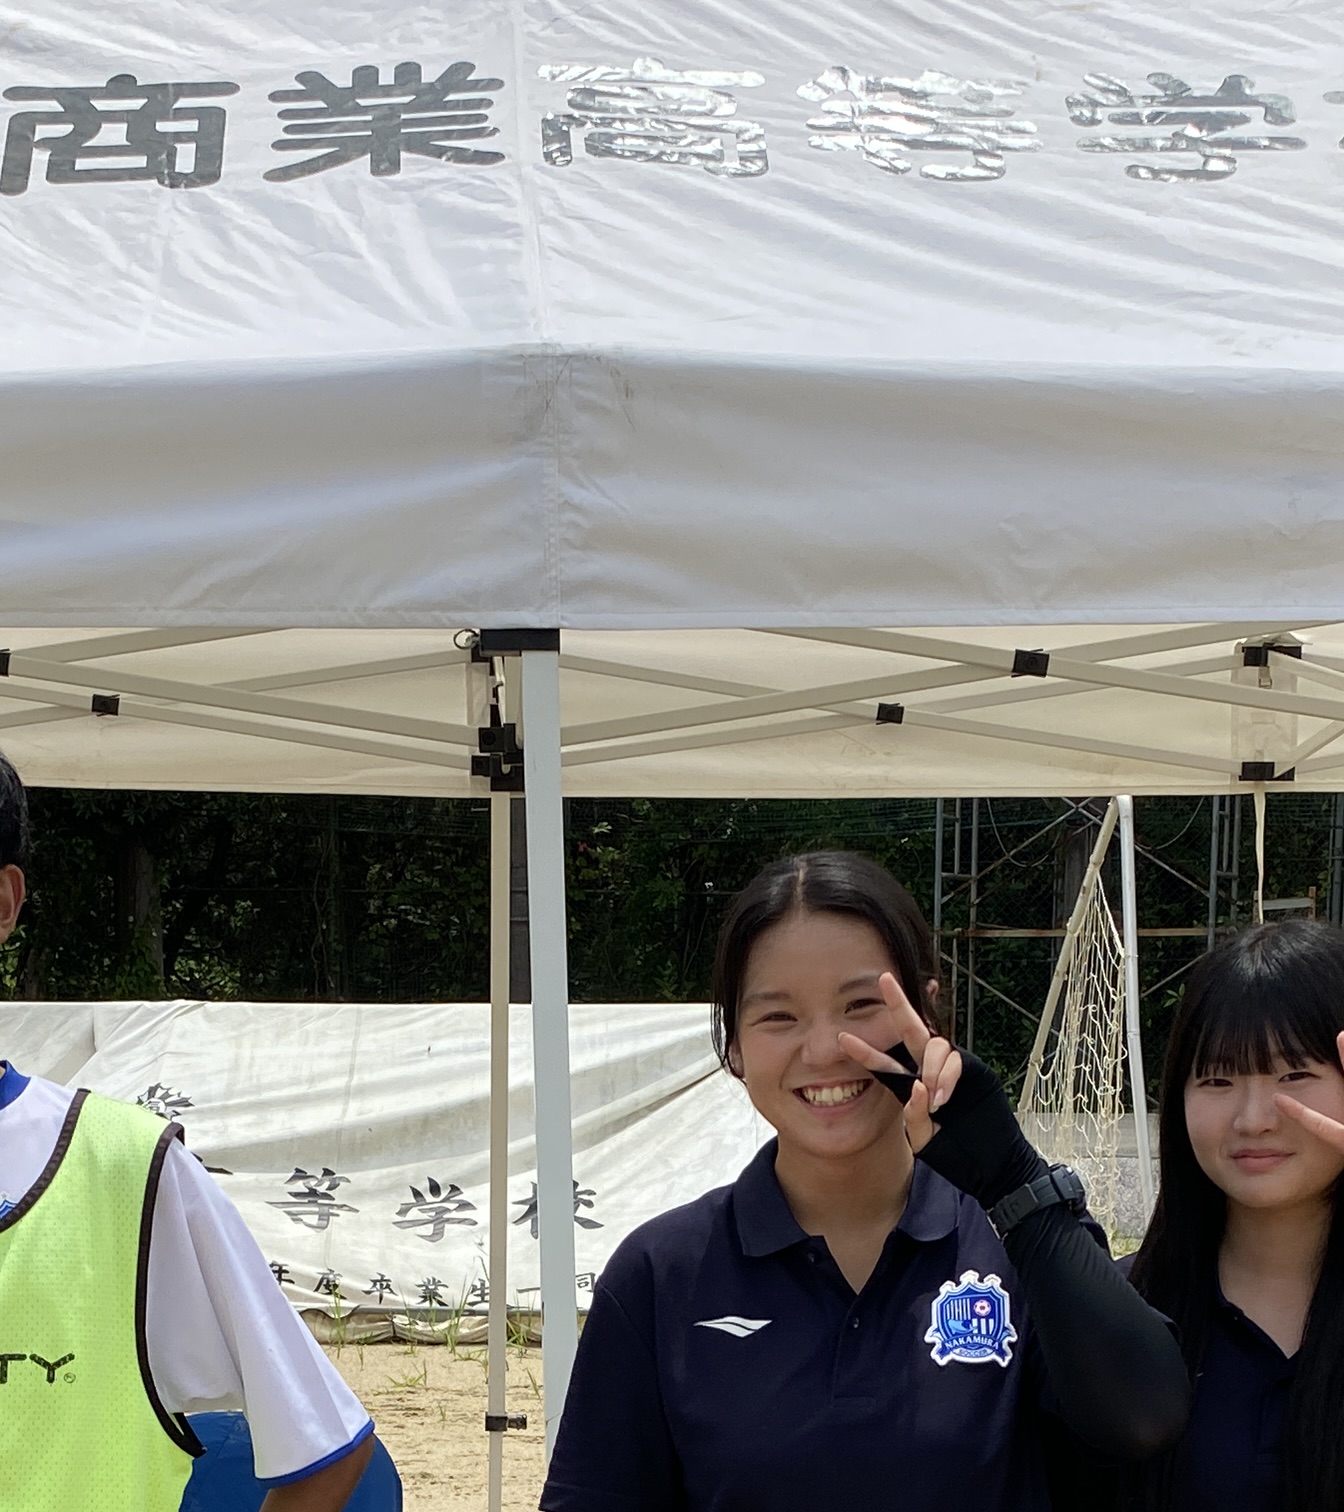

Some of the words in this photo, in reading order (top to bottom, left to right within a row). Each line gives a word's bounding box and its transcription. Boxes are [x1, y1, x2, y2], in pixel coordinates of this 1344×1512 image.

[191, 1152, 605, 1243] 等学校
[945, 1335, 999, 1350] NAKAMURA
